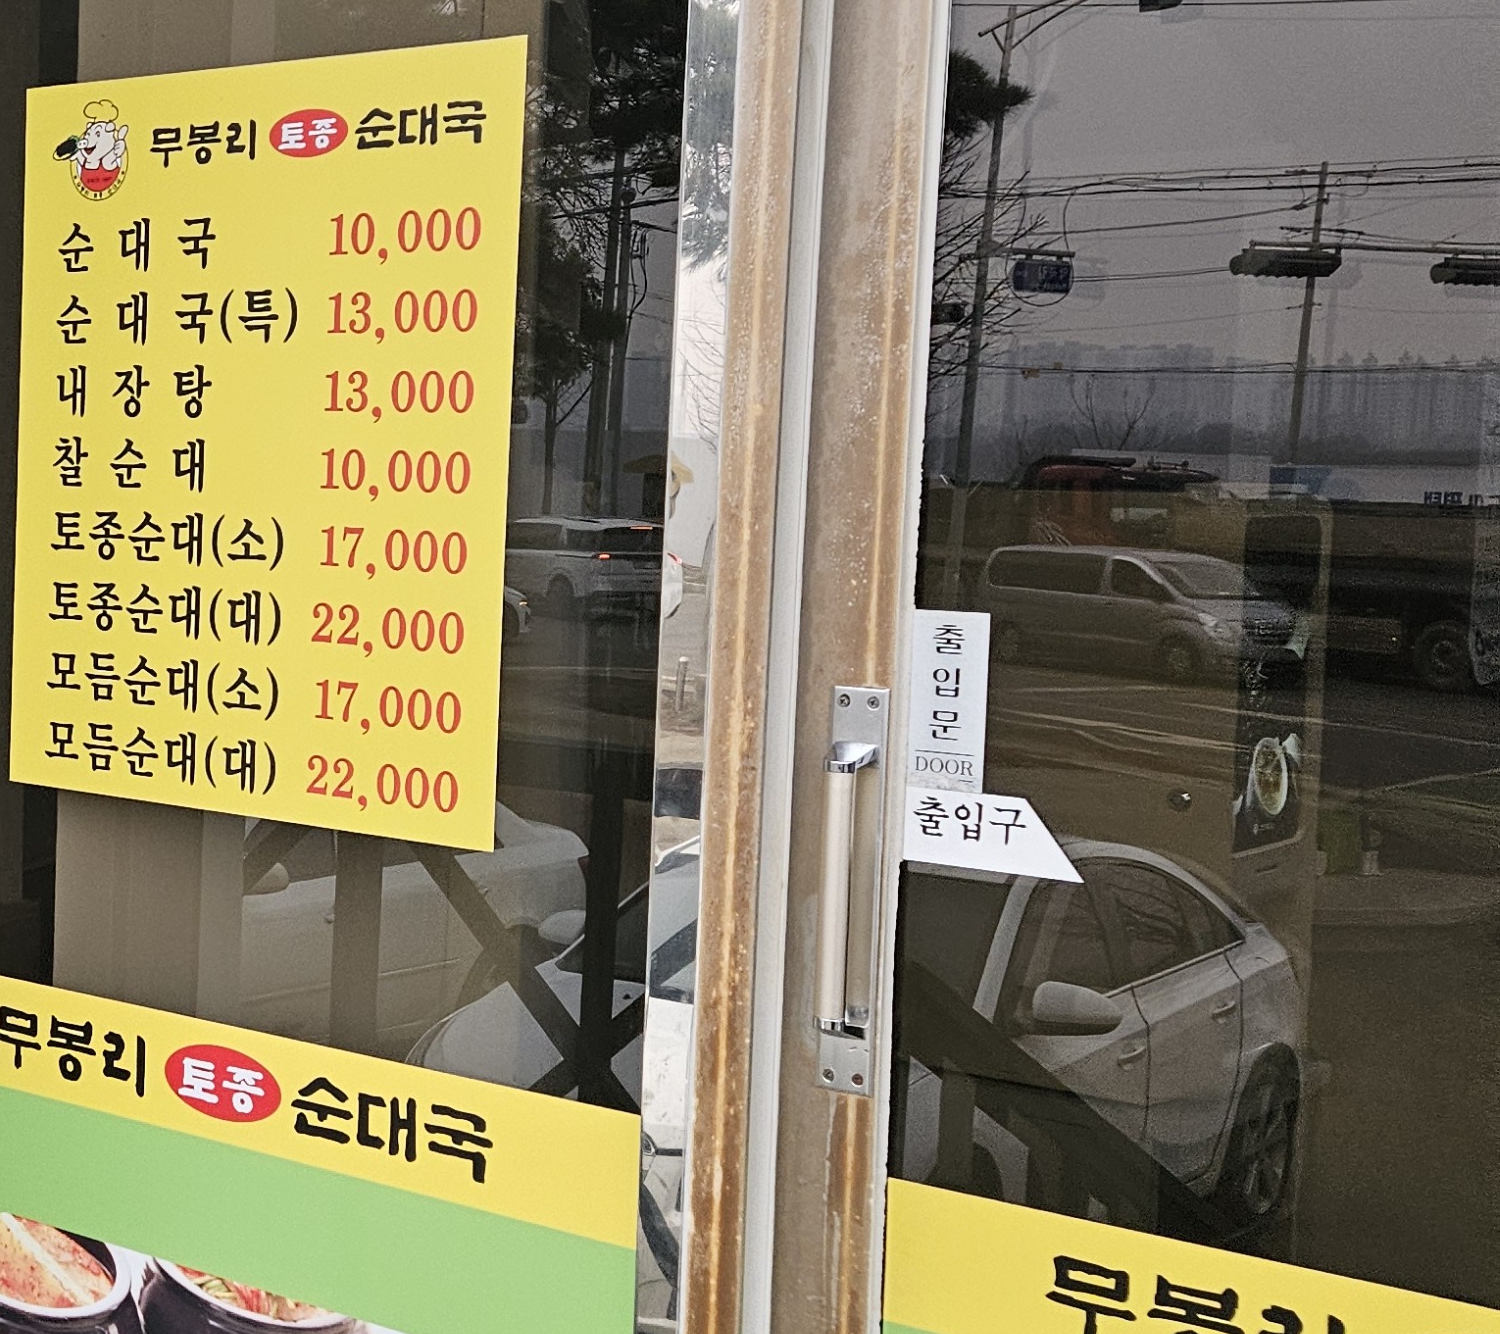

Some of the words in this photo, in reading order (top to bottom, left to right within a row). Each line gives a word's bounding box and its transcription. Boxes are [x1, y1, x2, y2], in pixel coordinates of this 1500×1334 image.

[149, 119, 257, 165] 무봉리
[278, 121, 340, 155] 토종
[354, 100, 487, 150] 순대국
[329, 206, 481, 265] 10,000
[327, 288, 478, 344] 13,000
[324, 370, 474, 424] 13,000
[320, 448, 471, 502] 10,000
[50, 510, 284, 571] 토종순대(소)
[320, 525, 468, 580] 17,000
[48, 581, 281, 646] 토종순대(대)
[311, 602, 465, 658] 22,000
[46, 652, 280, 722] 모듬순대(소)
[314, 679, 462, 735] 17,000
[44, 720, 278, 796] 모듬순대(대)
[306, 754, 459, 813] 22,000
[915, 756, 974, 777] DOOR
[913, 796, 1027, 845] 출입구
[178, 1056, 265, 1114] 토종
[290, 1076, 494, 1184] 순대국
